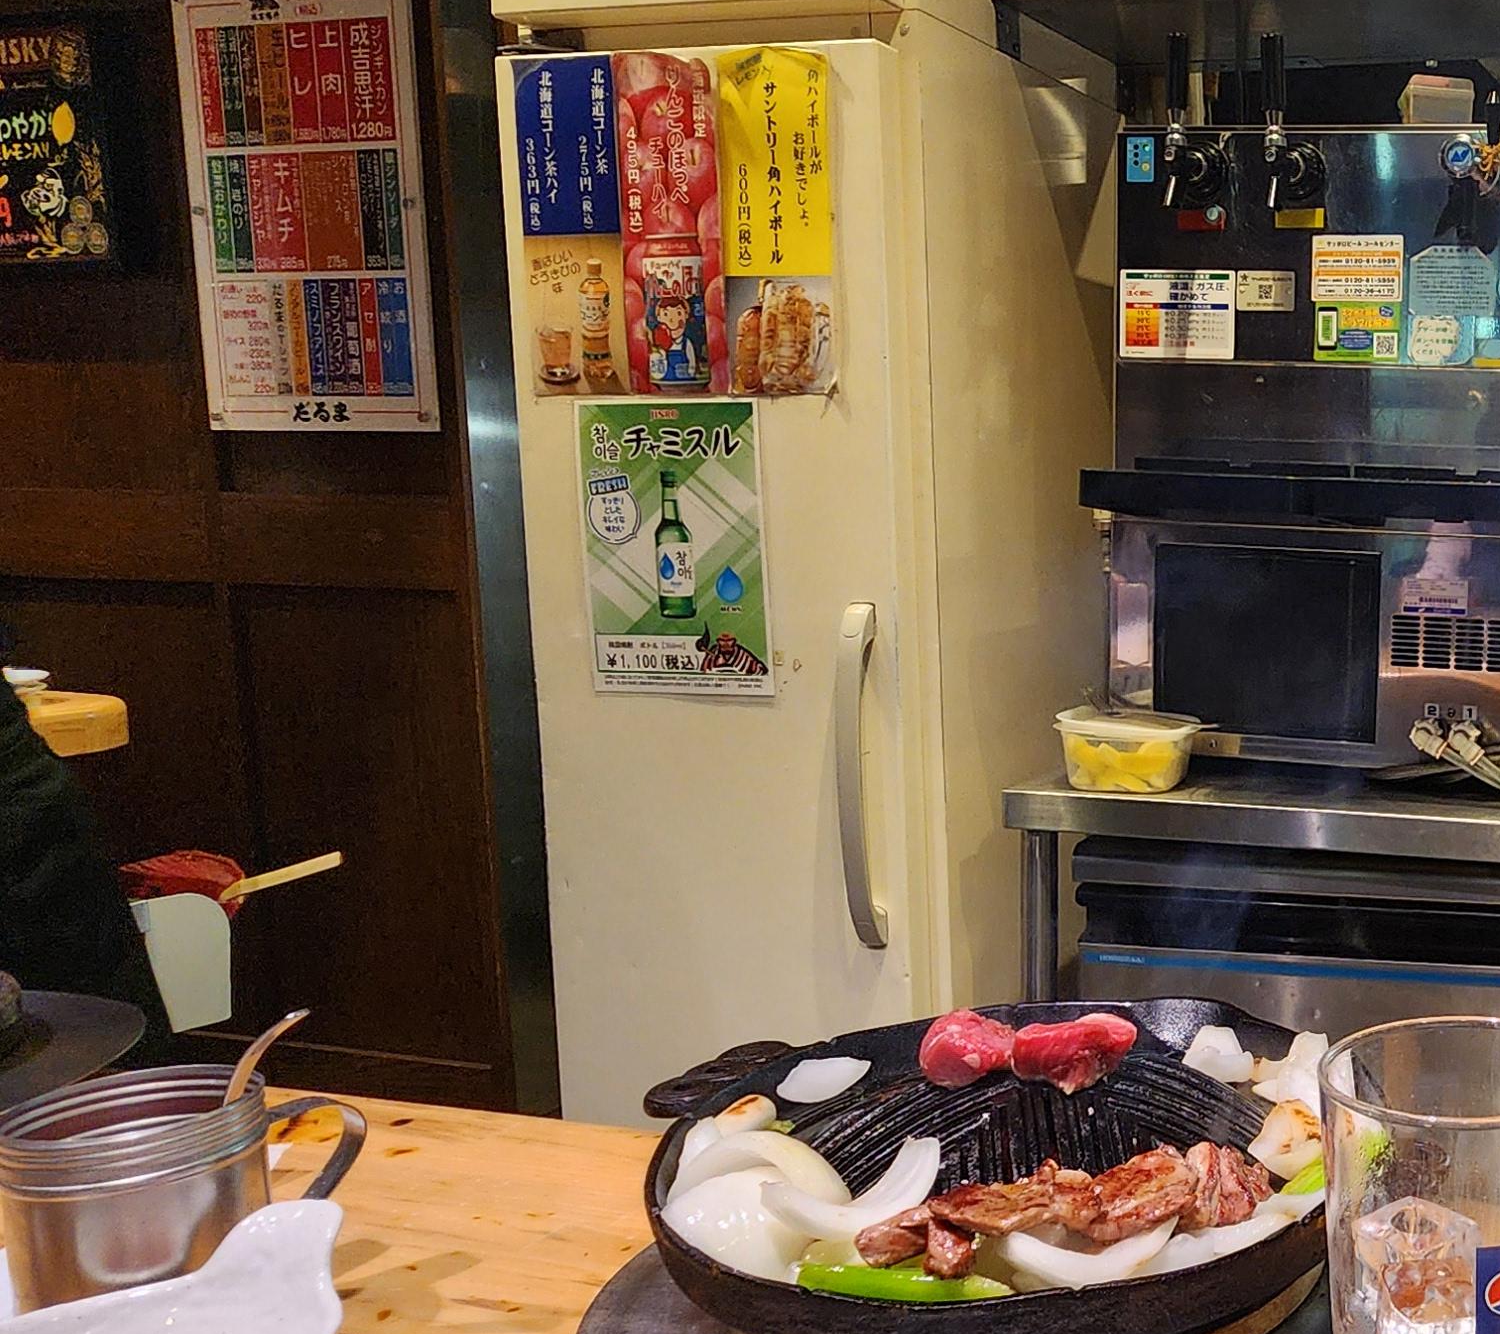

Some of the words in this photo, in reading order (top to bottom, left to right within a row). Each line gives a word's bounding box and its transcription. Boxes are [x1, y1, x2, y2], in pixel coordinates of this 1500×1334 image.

[350, 23, 375, 119] 成吉思汗
[538, 71, 560, 205] 北海道コーン茶ハイ
[589, 68, 609, 176] 北海道コーン茶
[273, 158, 295, 243] キムチ
[625, 126, 644, 234] 495円(税込)
[648, 137, 667, 218] チューハイ
[763, 82, 784, 265] サントリー角ハイボール
[292, 401, 352, 423] だるま
[624, 426, 740, 459] チャミスル
